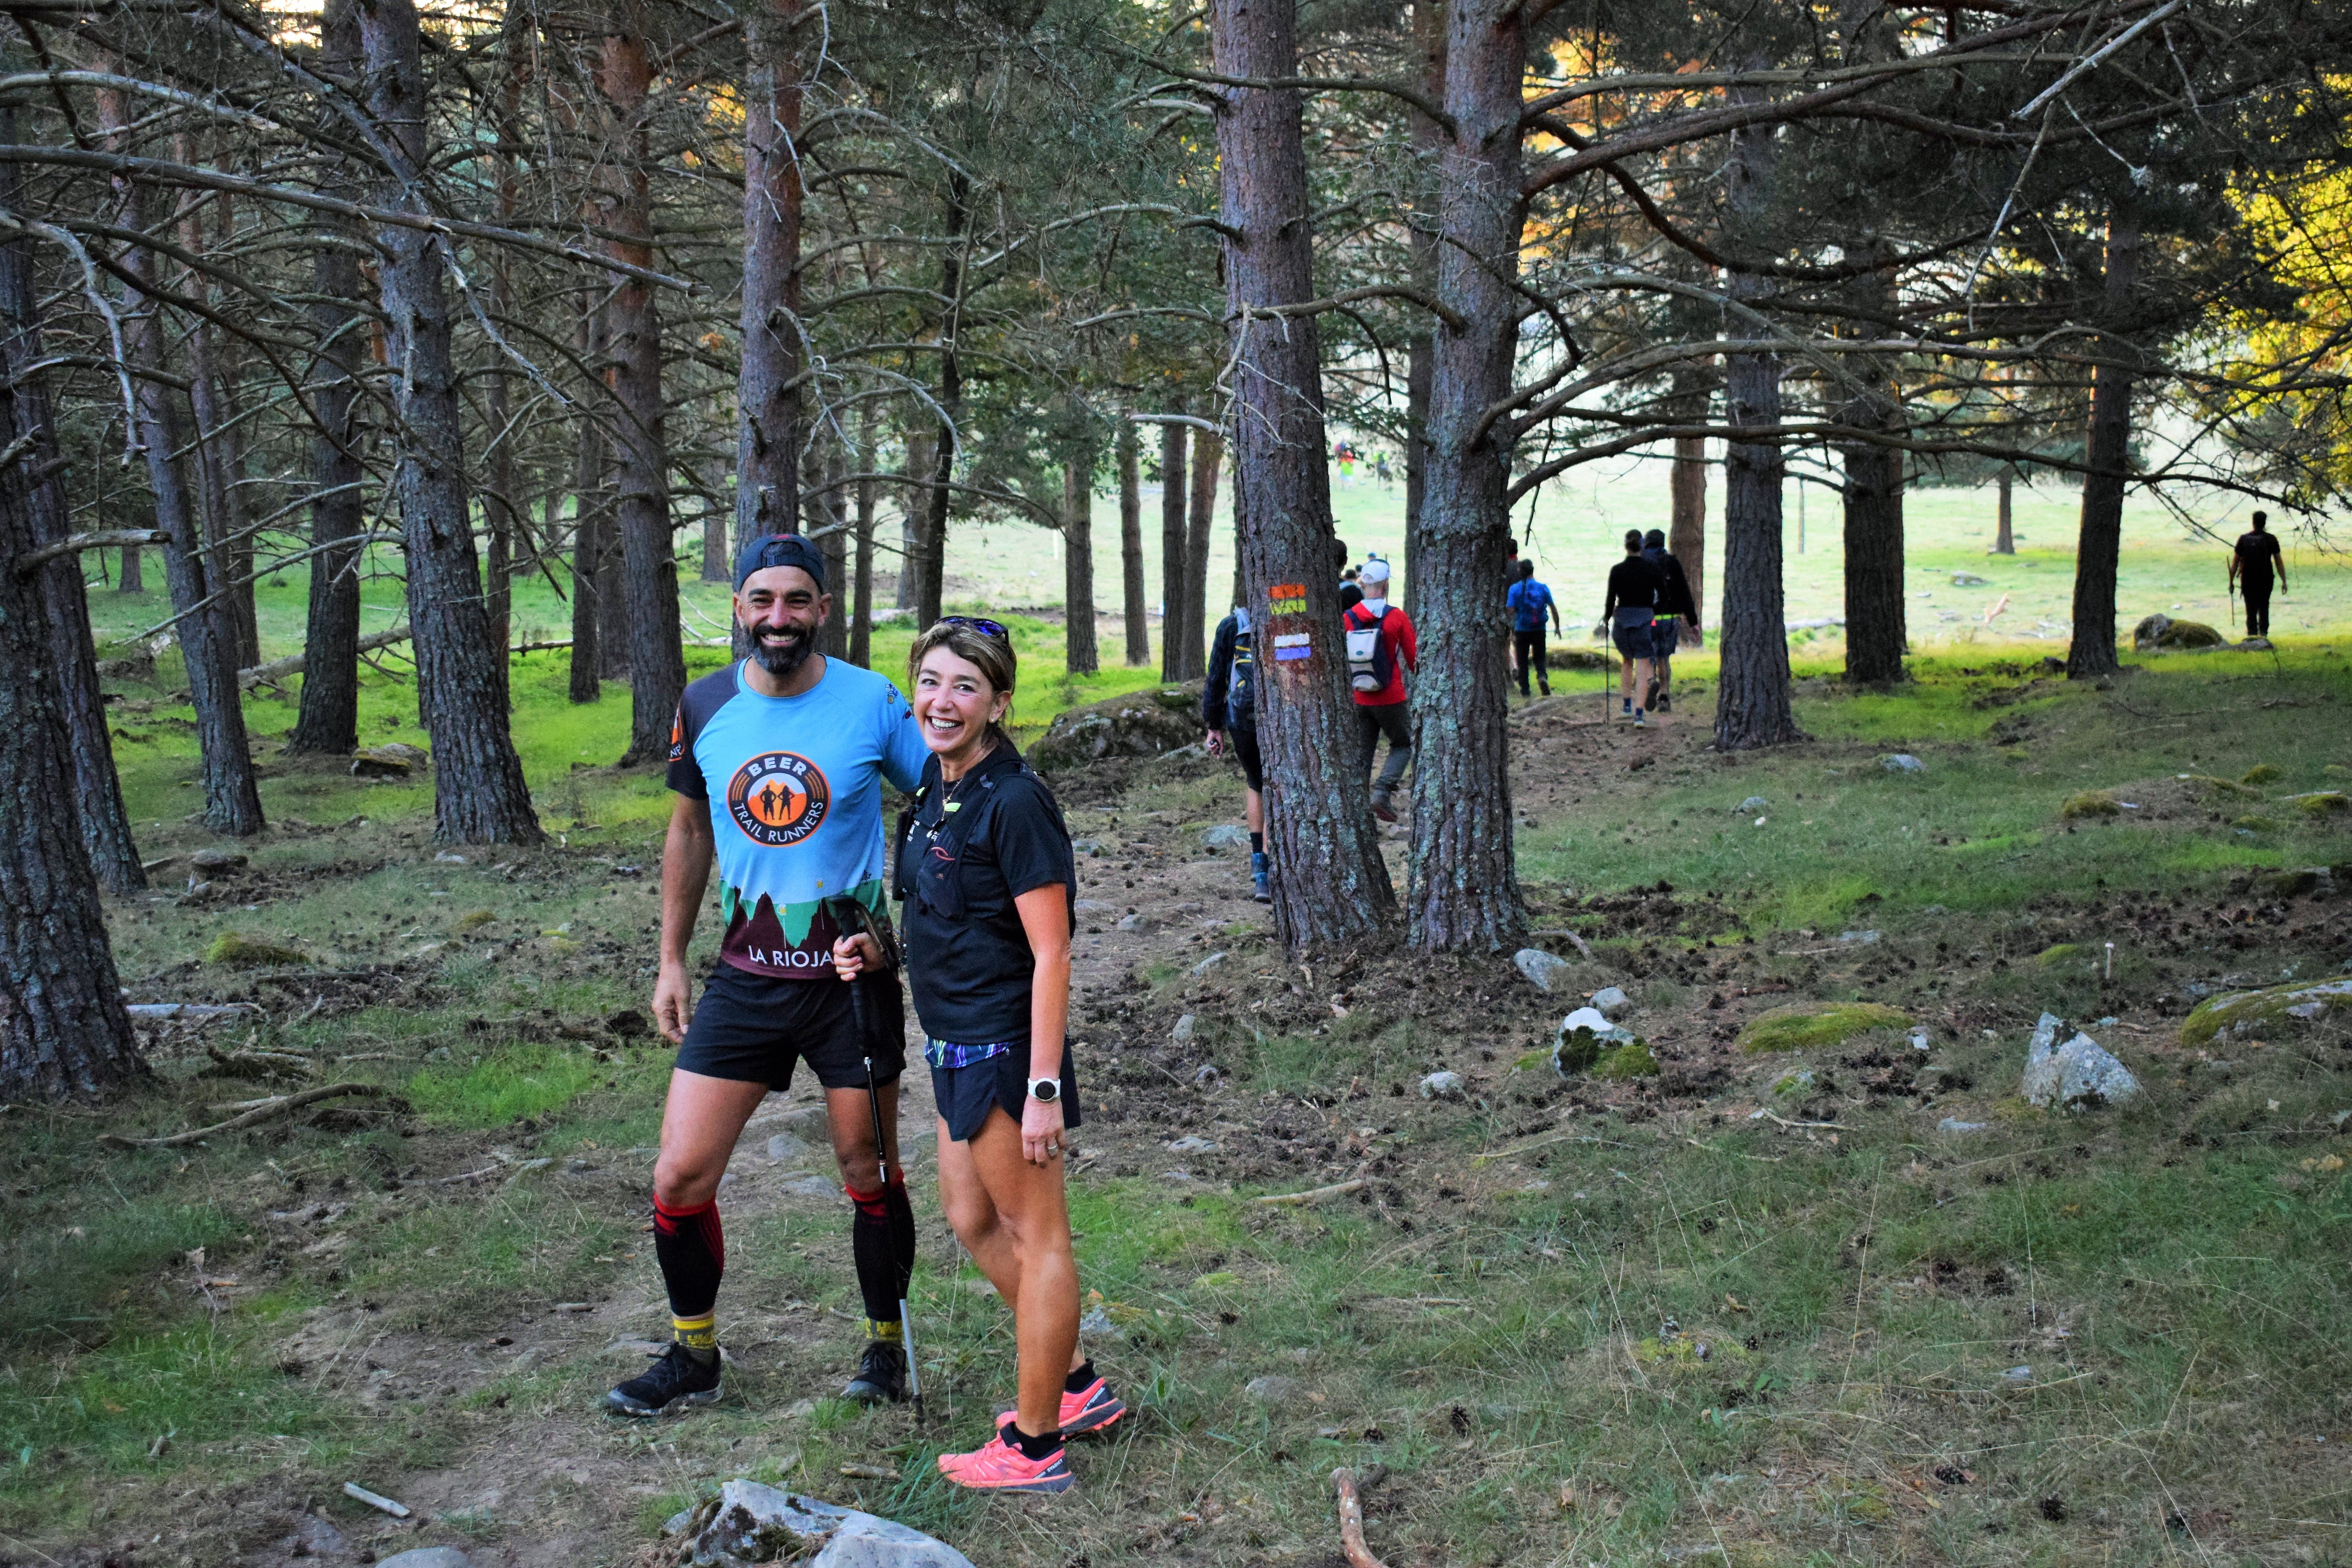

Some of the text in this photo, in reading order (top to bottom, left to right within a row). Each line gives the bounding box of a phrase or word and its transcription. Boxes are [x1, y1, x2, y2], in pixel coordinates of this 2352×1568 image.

[748, 757, 807, 777] BEER
[734, 802, 824, 842] TRAIL RUNNERS
[749, 945, 835, 967] LA RIOJA
